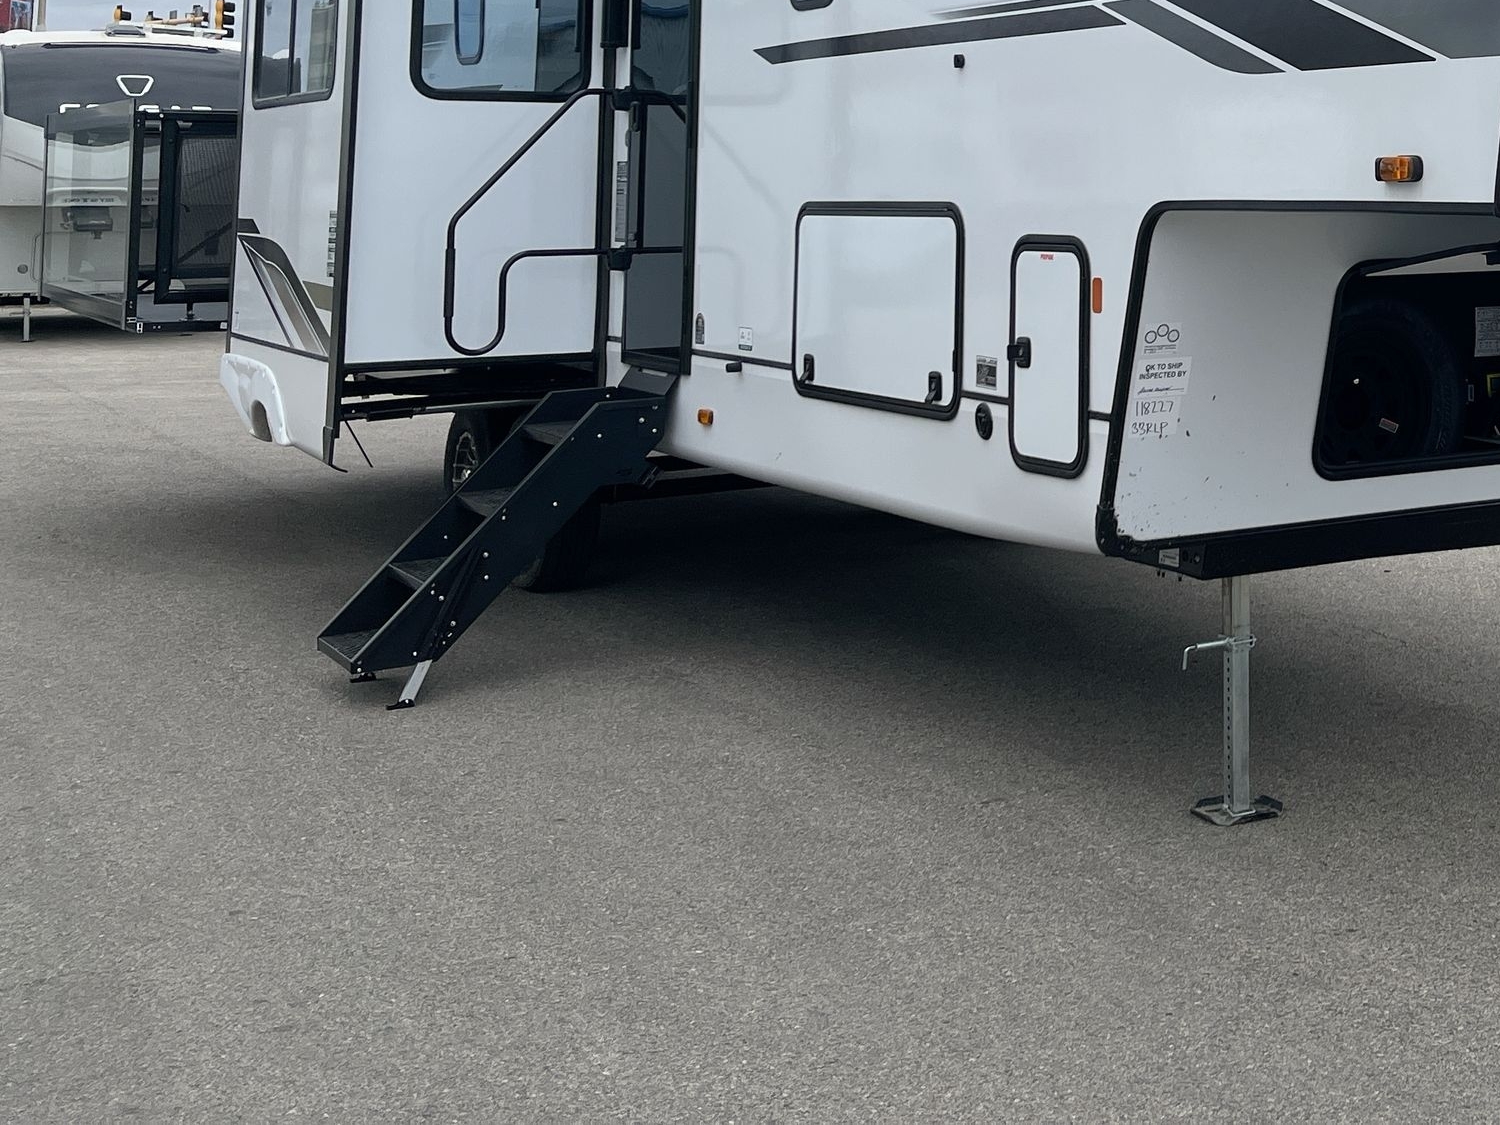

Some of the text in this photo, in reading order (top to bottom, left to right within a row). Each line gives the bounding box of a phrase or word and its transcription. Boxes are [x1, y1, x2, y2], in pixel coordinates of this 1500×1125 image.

[1167, 362, 1183, 370] SHIP
[1139, 370, 1187, 380] INSPECTED BY
